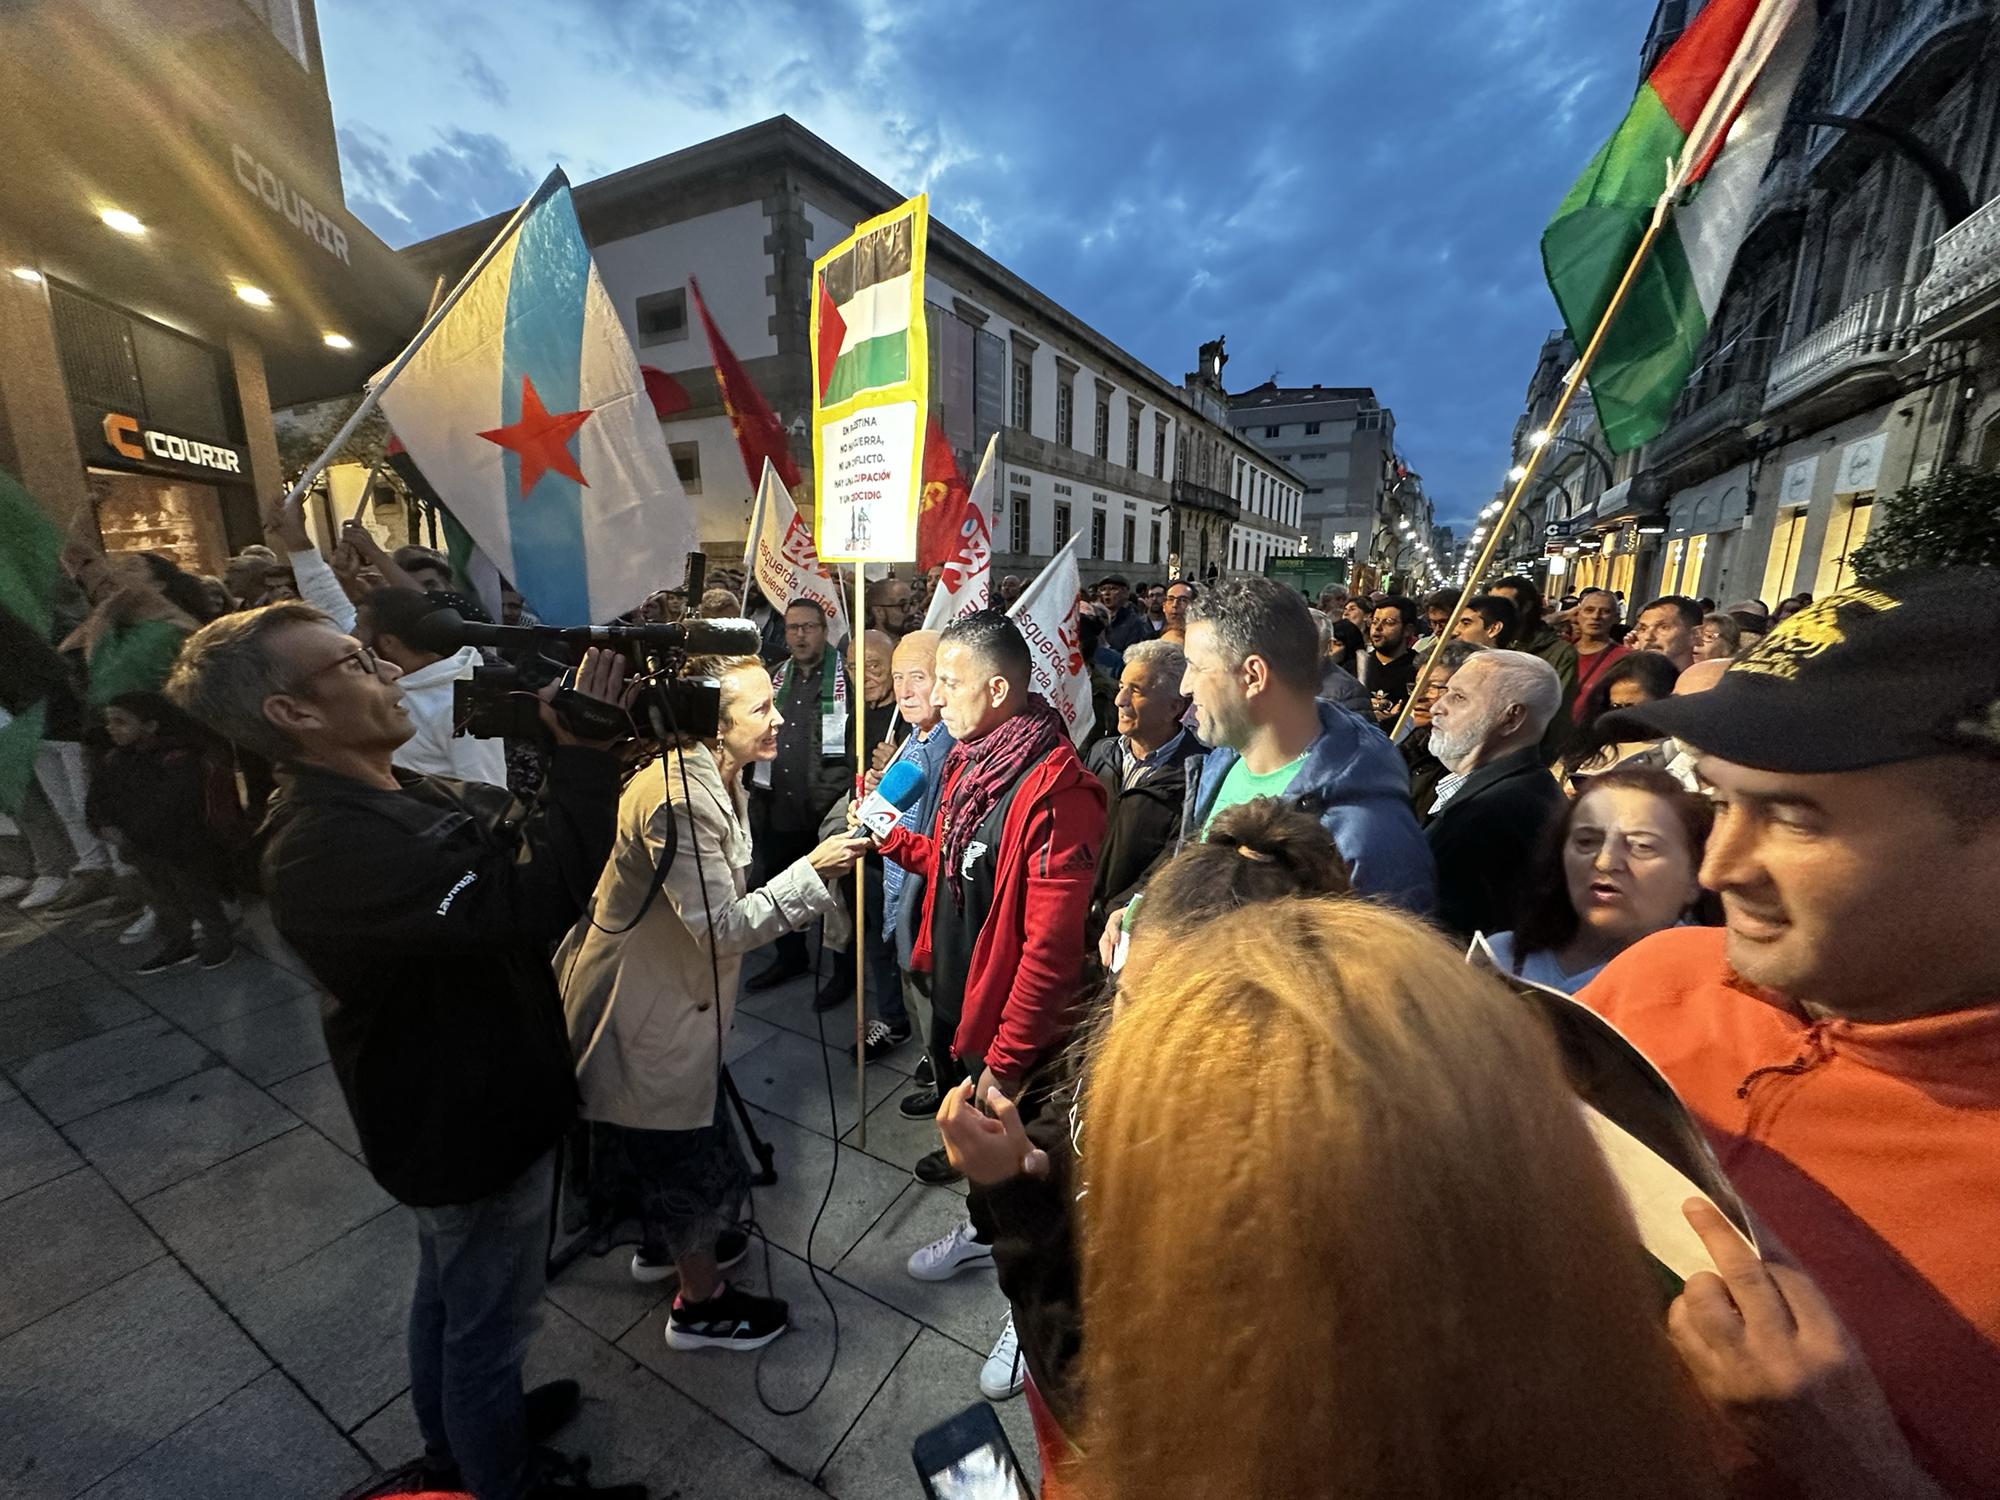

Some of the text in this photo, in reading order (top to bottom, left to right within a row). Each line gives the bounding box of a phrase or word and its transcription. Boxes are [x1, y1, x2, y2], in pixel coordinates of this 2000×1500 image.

[232, 143, 351, 265] COURIR
[145, 430, 241, 474] COURIR
[760, 538, 799, 591] esquerda
[864, 816, 888, 835] ATLAS
